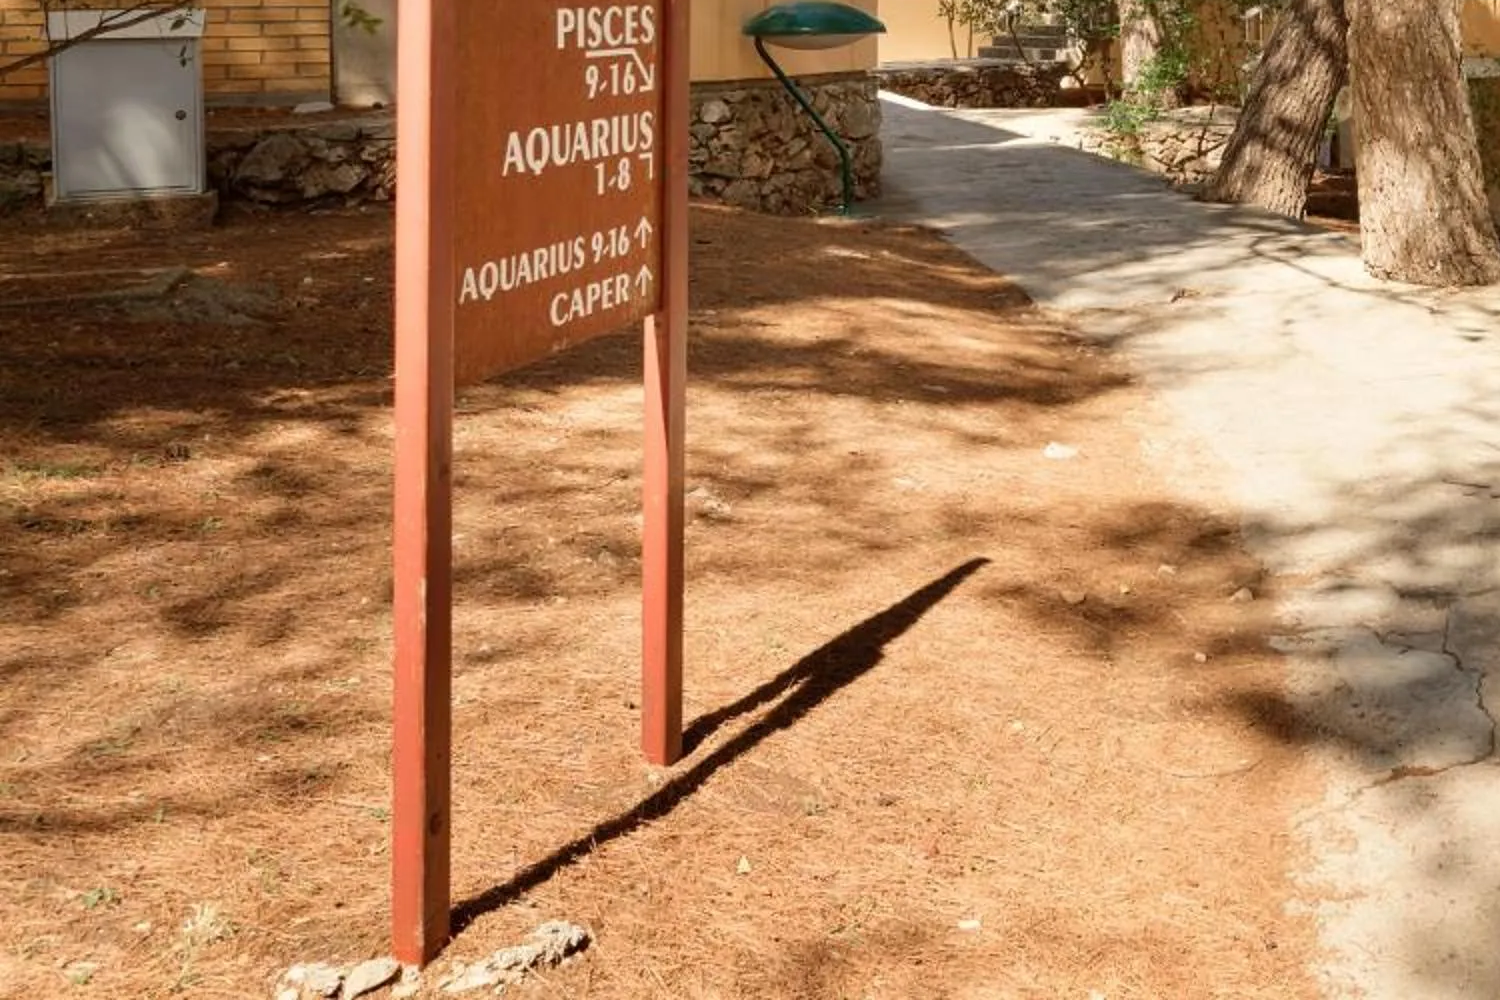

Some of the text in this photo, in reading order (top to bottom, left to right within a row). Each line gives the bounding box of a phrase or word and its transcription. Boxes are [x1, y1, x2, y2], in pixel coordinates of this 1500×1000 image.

[557, 5, 655, 49] PISCES
[585, 61, 636, 99] 9-16
[502, 111, 653, 176] AQUARIUS
[595, 157, 631, 195] 1-8
[459, 225, 630, 304] AQUARIUS 9-16
[550, 273, 630, 326] CAPER
